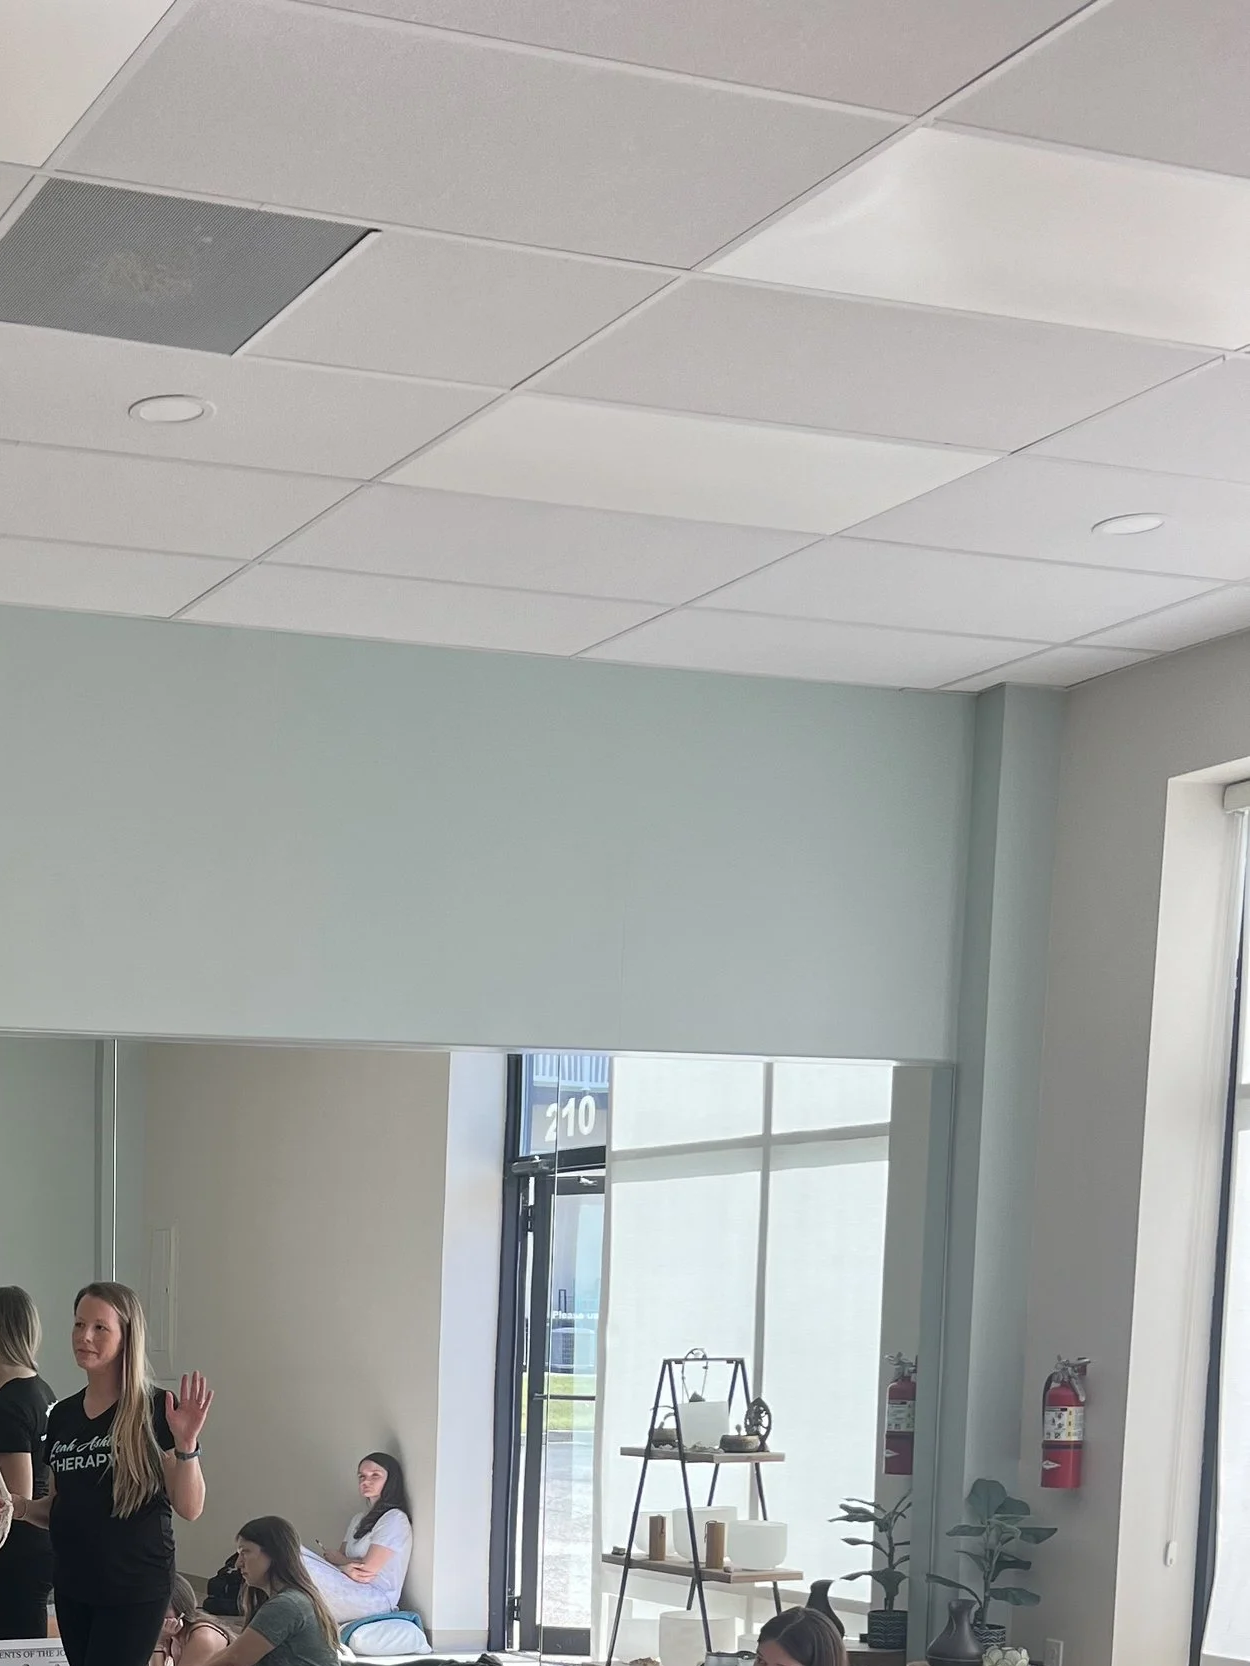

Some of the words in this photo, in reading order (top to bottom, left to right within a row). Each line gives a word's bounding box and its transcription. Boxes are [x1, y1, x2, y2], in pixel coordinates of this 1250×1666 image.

[544, 1095, 596, 1142] 210
[552, 1310, 584, 1320] Please
[23, 1650, 35, 1659] OF
[37, 1649, 54, 1658] THE
